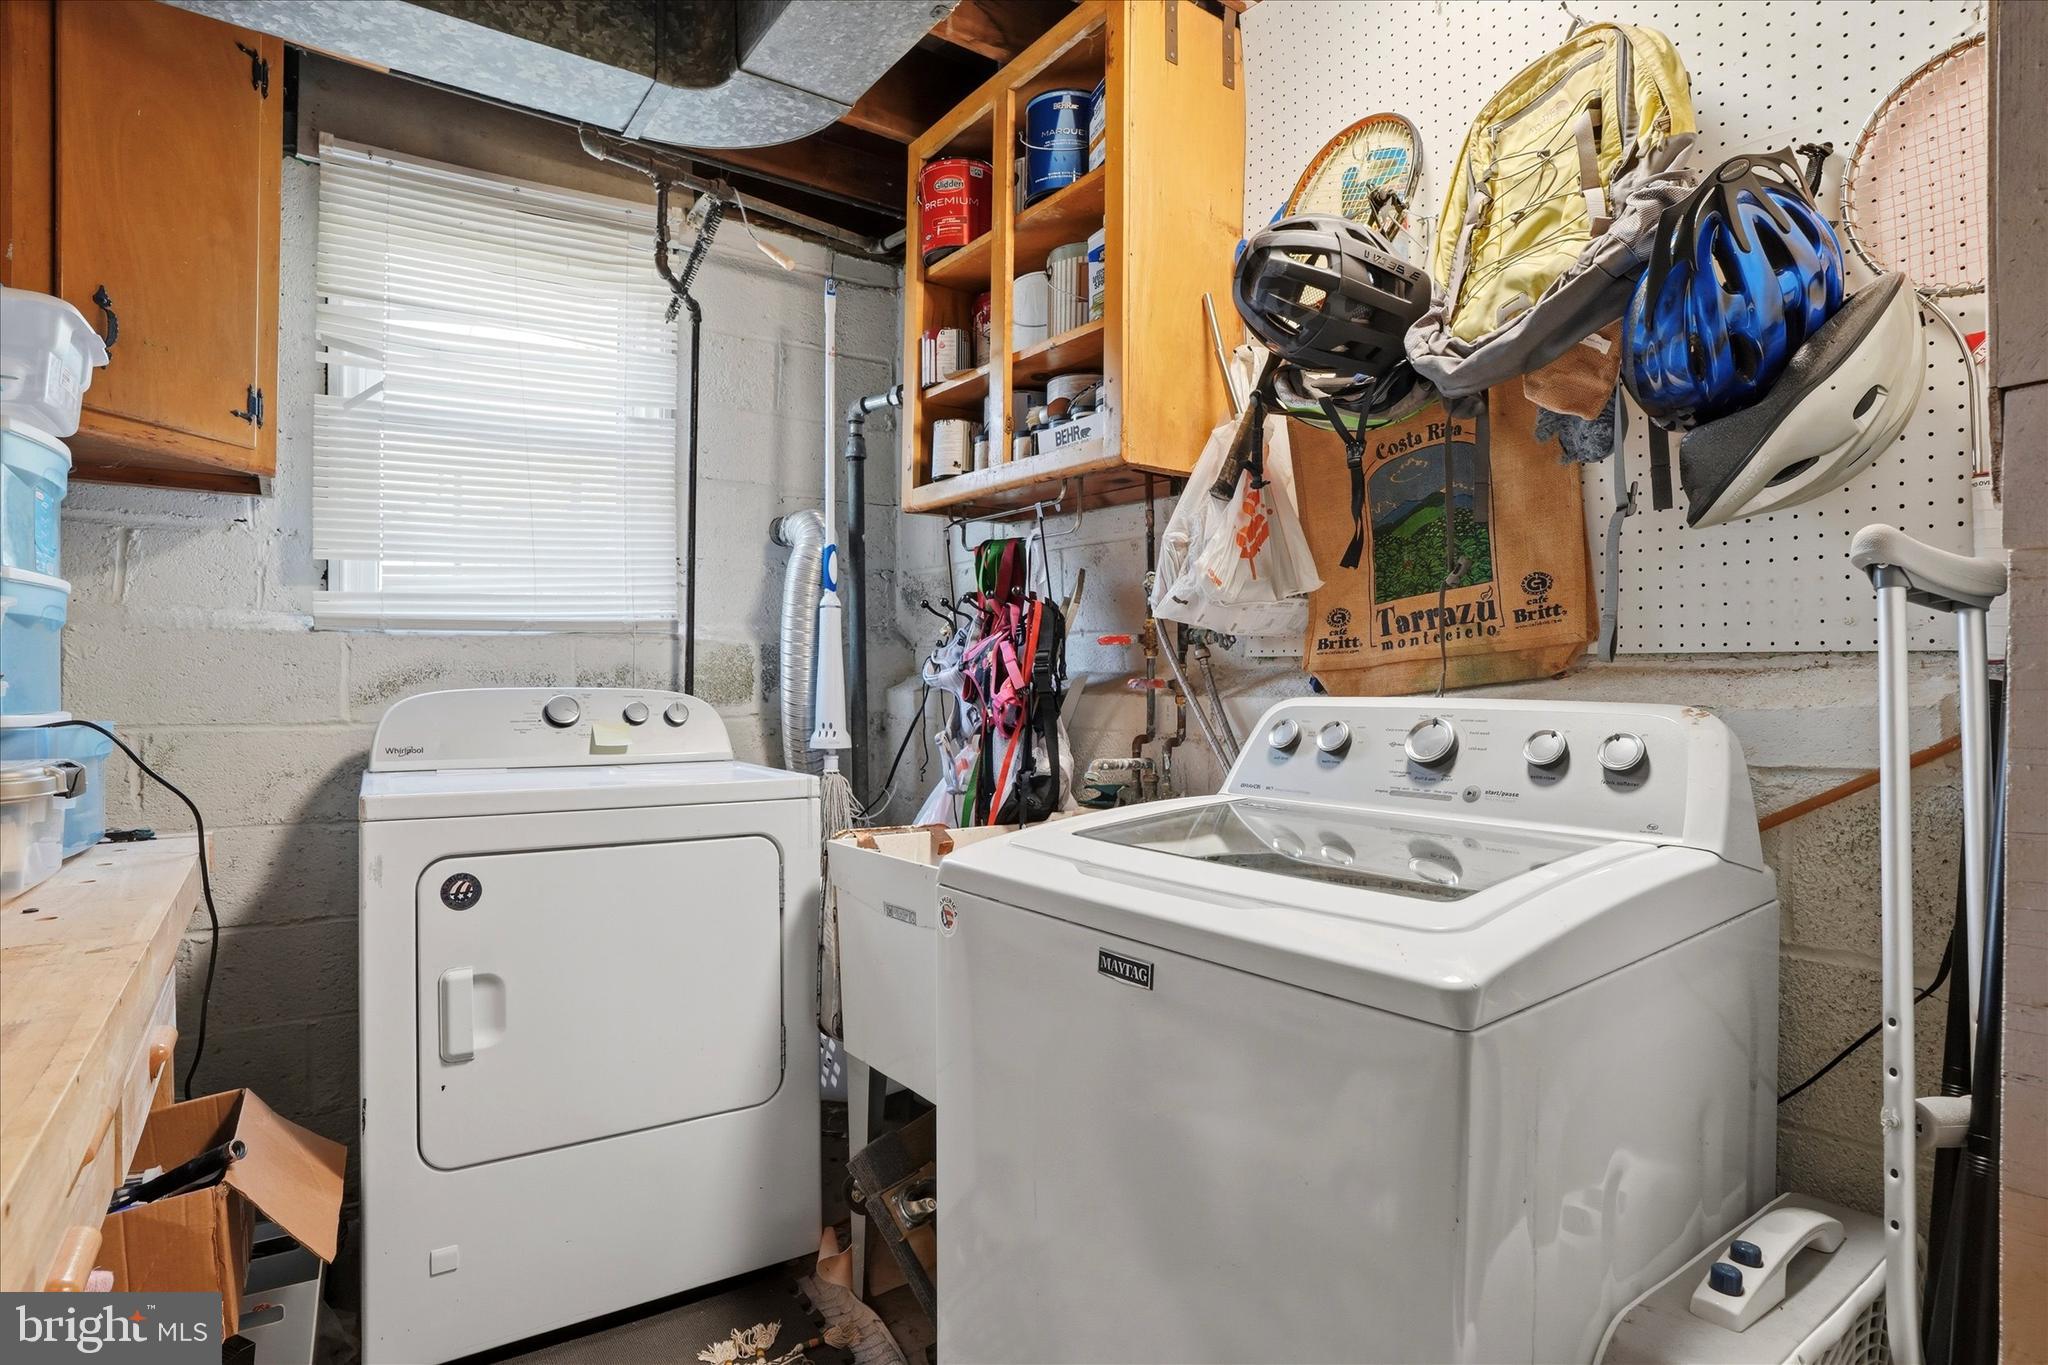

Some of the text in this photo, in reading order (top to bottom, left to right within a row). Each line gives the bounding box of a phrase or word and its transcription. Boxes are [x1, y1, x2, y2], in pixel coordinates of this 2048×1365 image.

[934, 178, 964, 191] Glidden
[924, 196, 980, 212] PREMIUM
[1055, 424, 1081, 447] BEHR
[1376, 422, 1463, 460] Costa Ria
[1512, 603, 1563, 624] Britt
[1317, 636, 1361, 651] Britt
[1381, 621, 1497, 652] montecielo
[385, 746, 424, 757] Whirlpool
[1484, 789, 1520, 799] start/pause
[1100, 955, 1148, 983] MAYTAG
